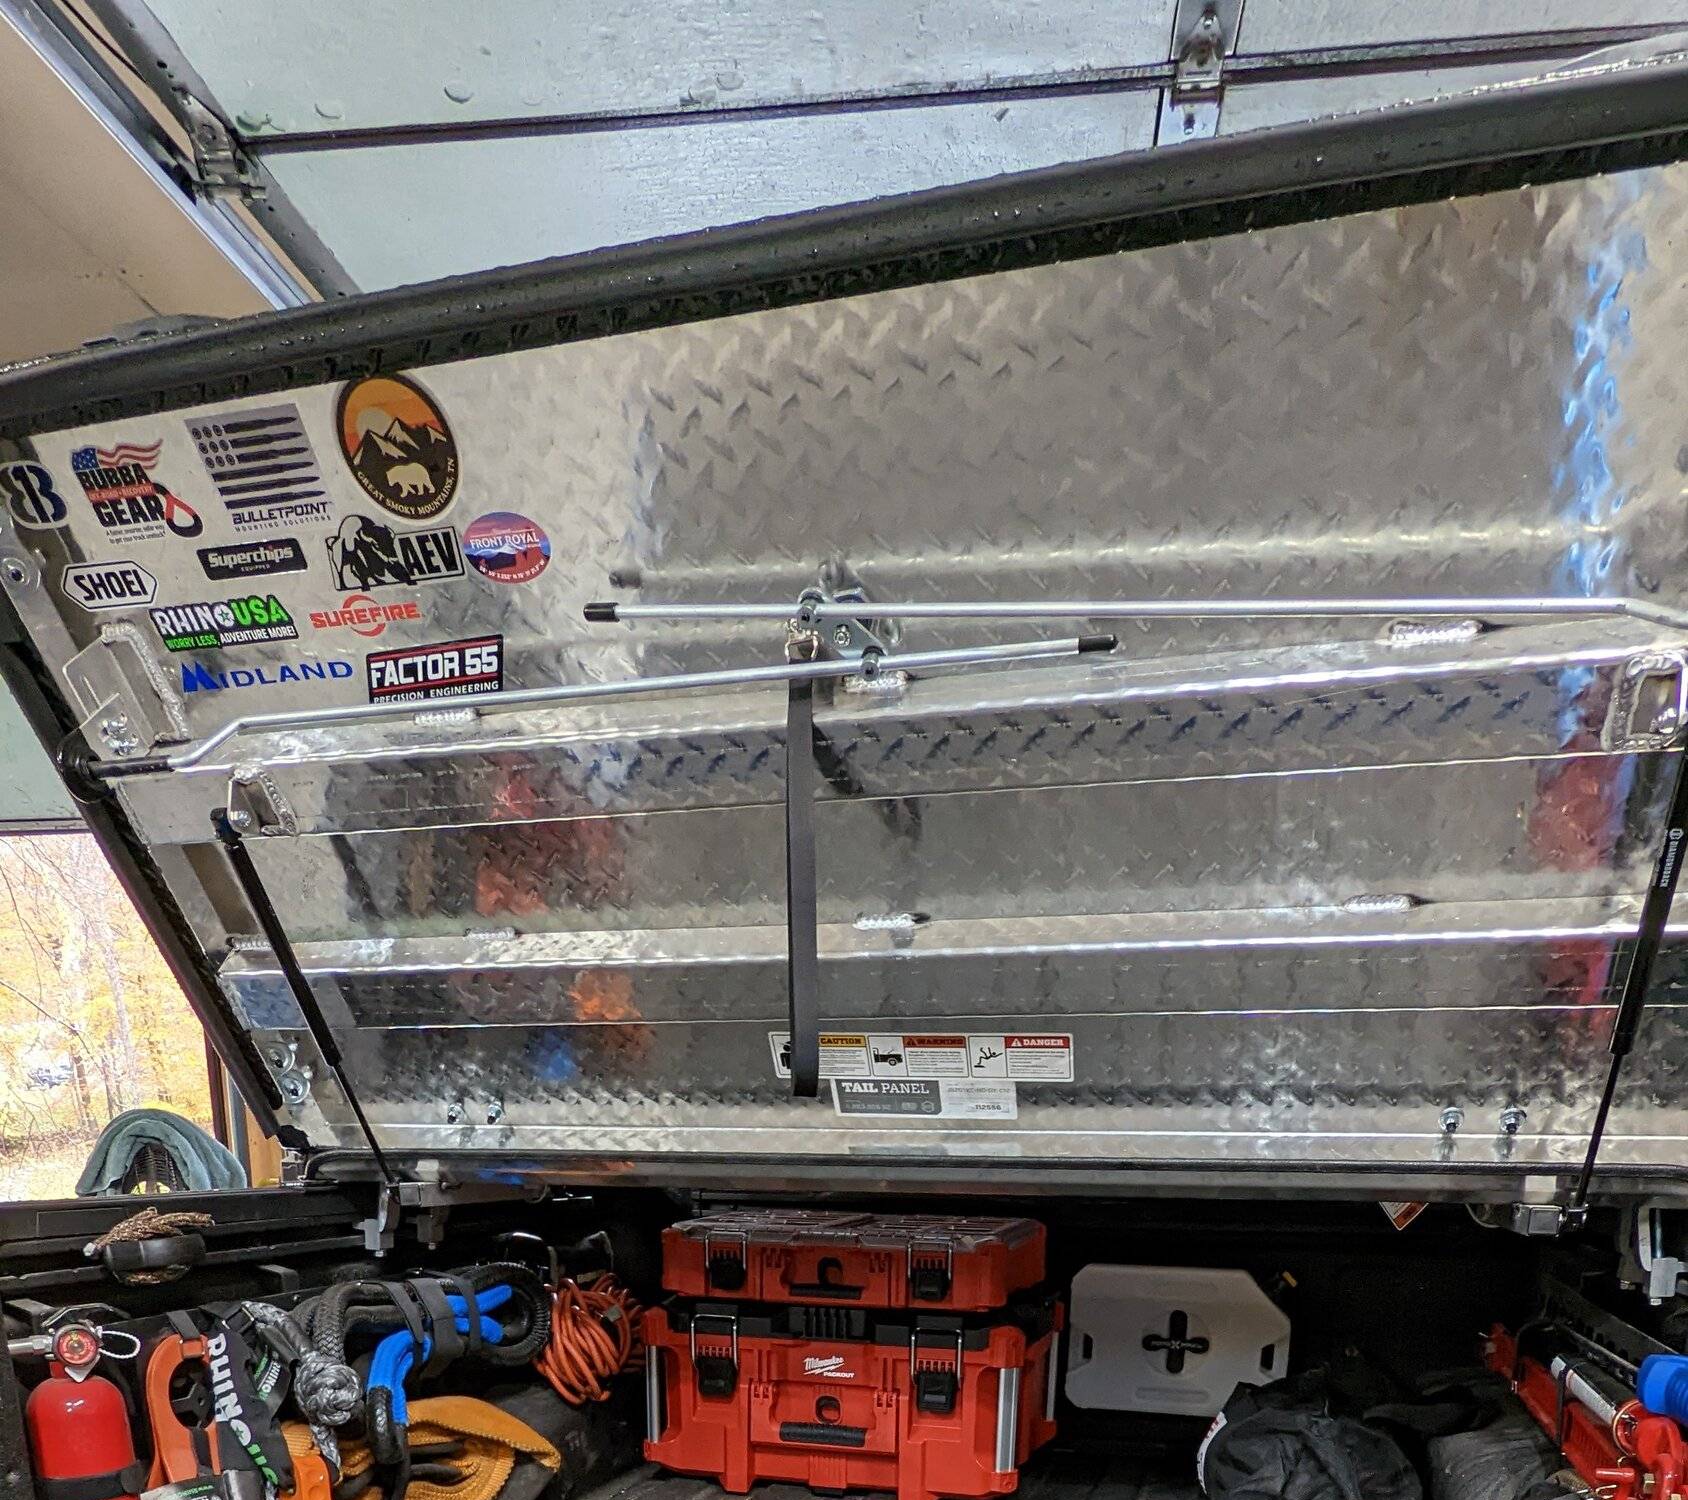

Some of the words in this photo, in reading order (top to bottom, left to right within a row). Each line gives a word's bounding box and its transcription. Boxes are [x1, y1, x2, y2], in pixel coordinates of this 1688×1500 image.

[75, 462, 153, 490] BUBBA
[357, 471, 385, 501] GREAT
[385, 499, 415, 515] SMOKY
[446, 457, 455, 474] TN
[92, 494, 166, 528] GEAR
[232, 502, 329, 525] BULLETPOINT
[284, 515, 331, 527] SOLUTIONS
[469, 536, 502, 549] FRONT
[504, 531, 540, 550] ROYAL
[208, 544, 293, 568] Superchips
[398, 532, 458, 576] AEV
[74, 569, 149, 601] SHOEI
[309, 602, 421, 629] SUREFIRE
[167, 635, 195, 649] WORRY
[197, 633, 220, 647] LESS,
[220, 627, 269, 644] ADVENTURE
[270, 624, 296, 639] MORE!
[181, 660, 353, 693] MIDLAND
[370, 651, 459, 689] FACTOR
[465, 645, 498, 676] 55
[373, 690, 424, 704] PRECISION
[430, 681, 499, 699] ENGINEERING
[820, 1037, 861, 1045] CAUTION
[1023, 1038, 1064, 1046] DANGER
[842, 1082, 879, 1093] TAIL
[881, 1083, 930, 1094] PANEL
[803, 1355, 845, 1371] Milwaukee
